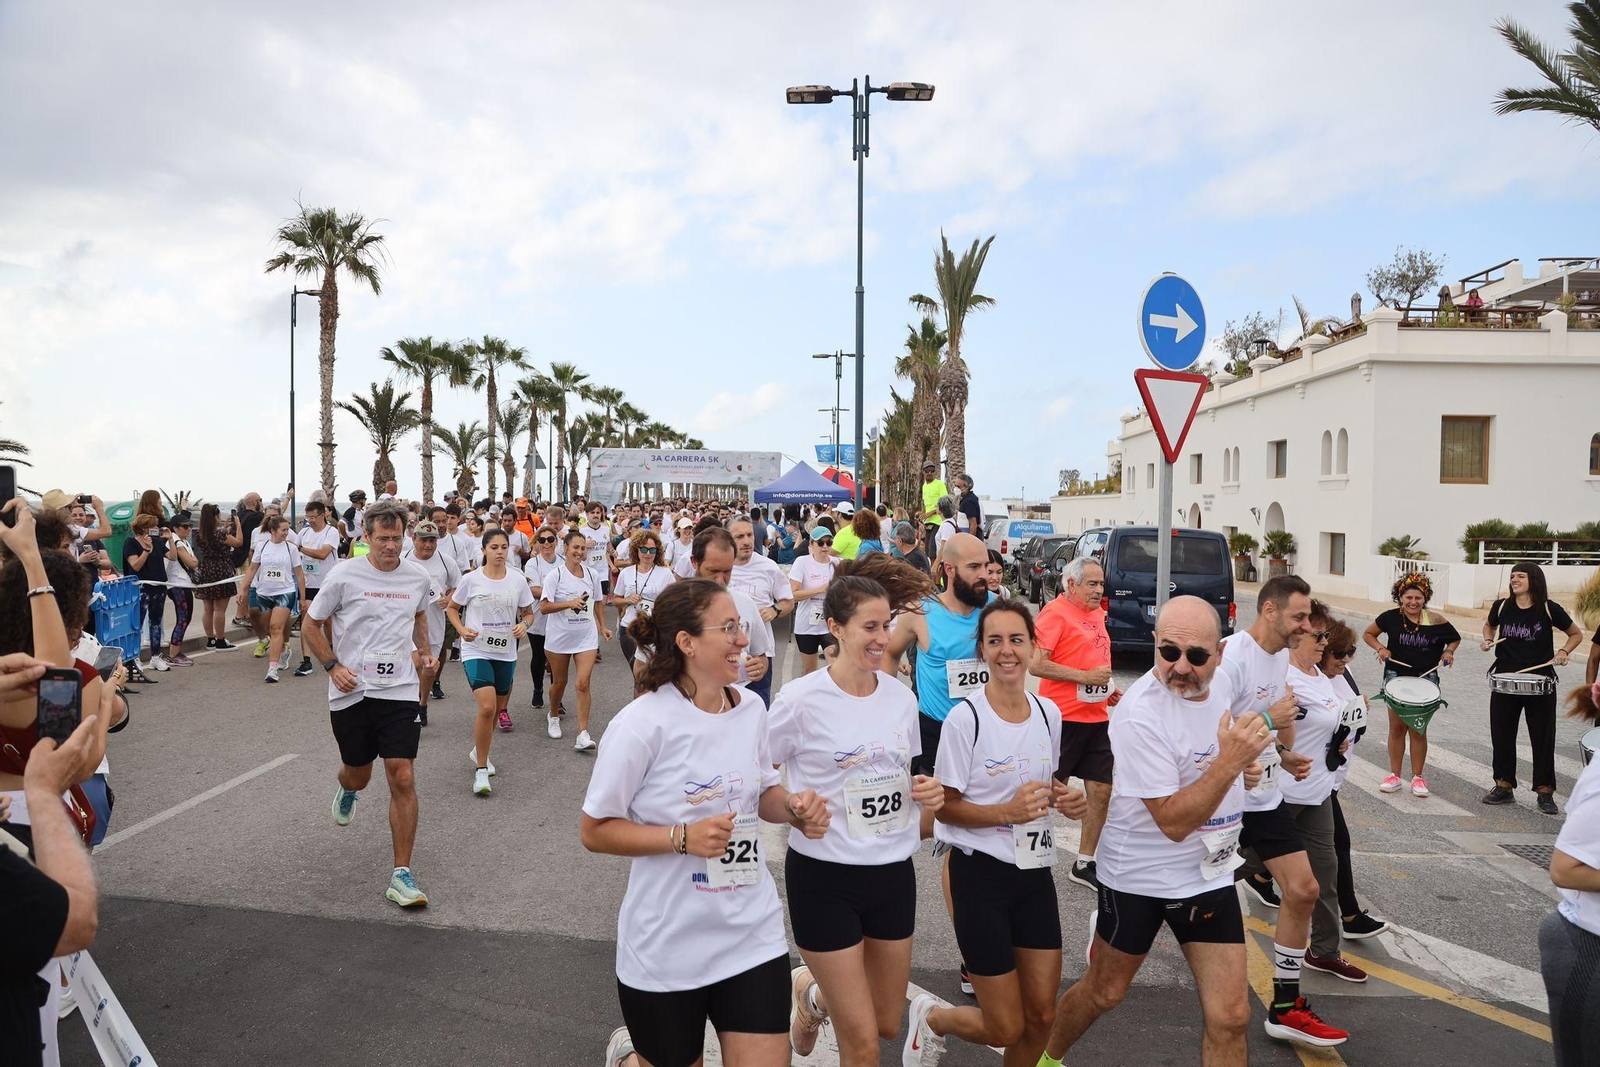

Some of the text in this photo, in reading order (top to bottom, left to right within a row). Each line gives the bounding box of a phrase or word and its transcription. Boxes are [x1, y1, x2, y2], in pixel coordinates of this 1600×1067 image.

[664, 455, 706, 463] CARRERA
[486, 636, 508, 648] 868
[376, 662, 394, 675] 52
[957, 670, 990, 687] 280
[1085, 684, 1109, 694] 879
[869, 774, 895, 784] CARRERA
[861, 791, 902, 819] 528
[1026, 829, 1053, 851] 746
